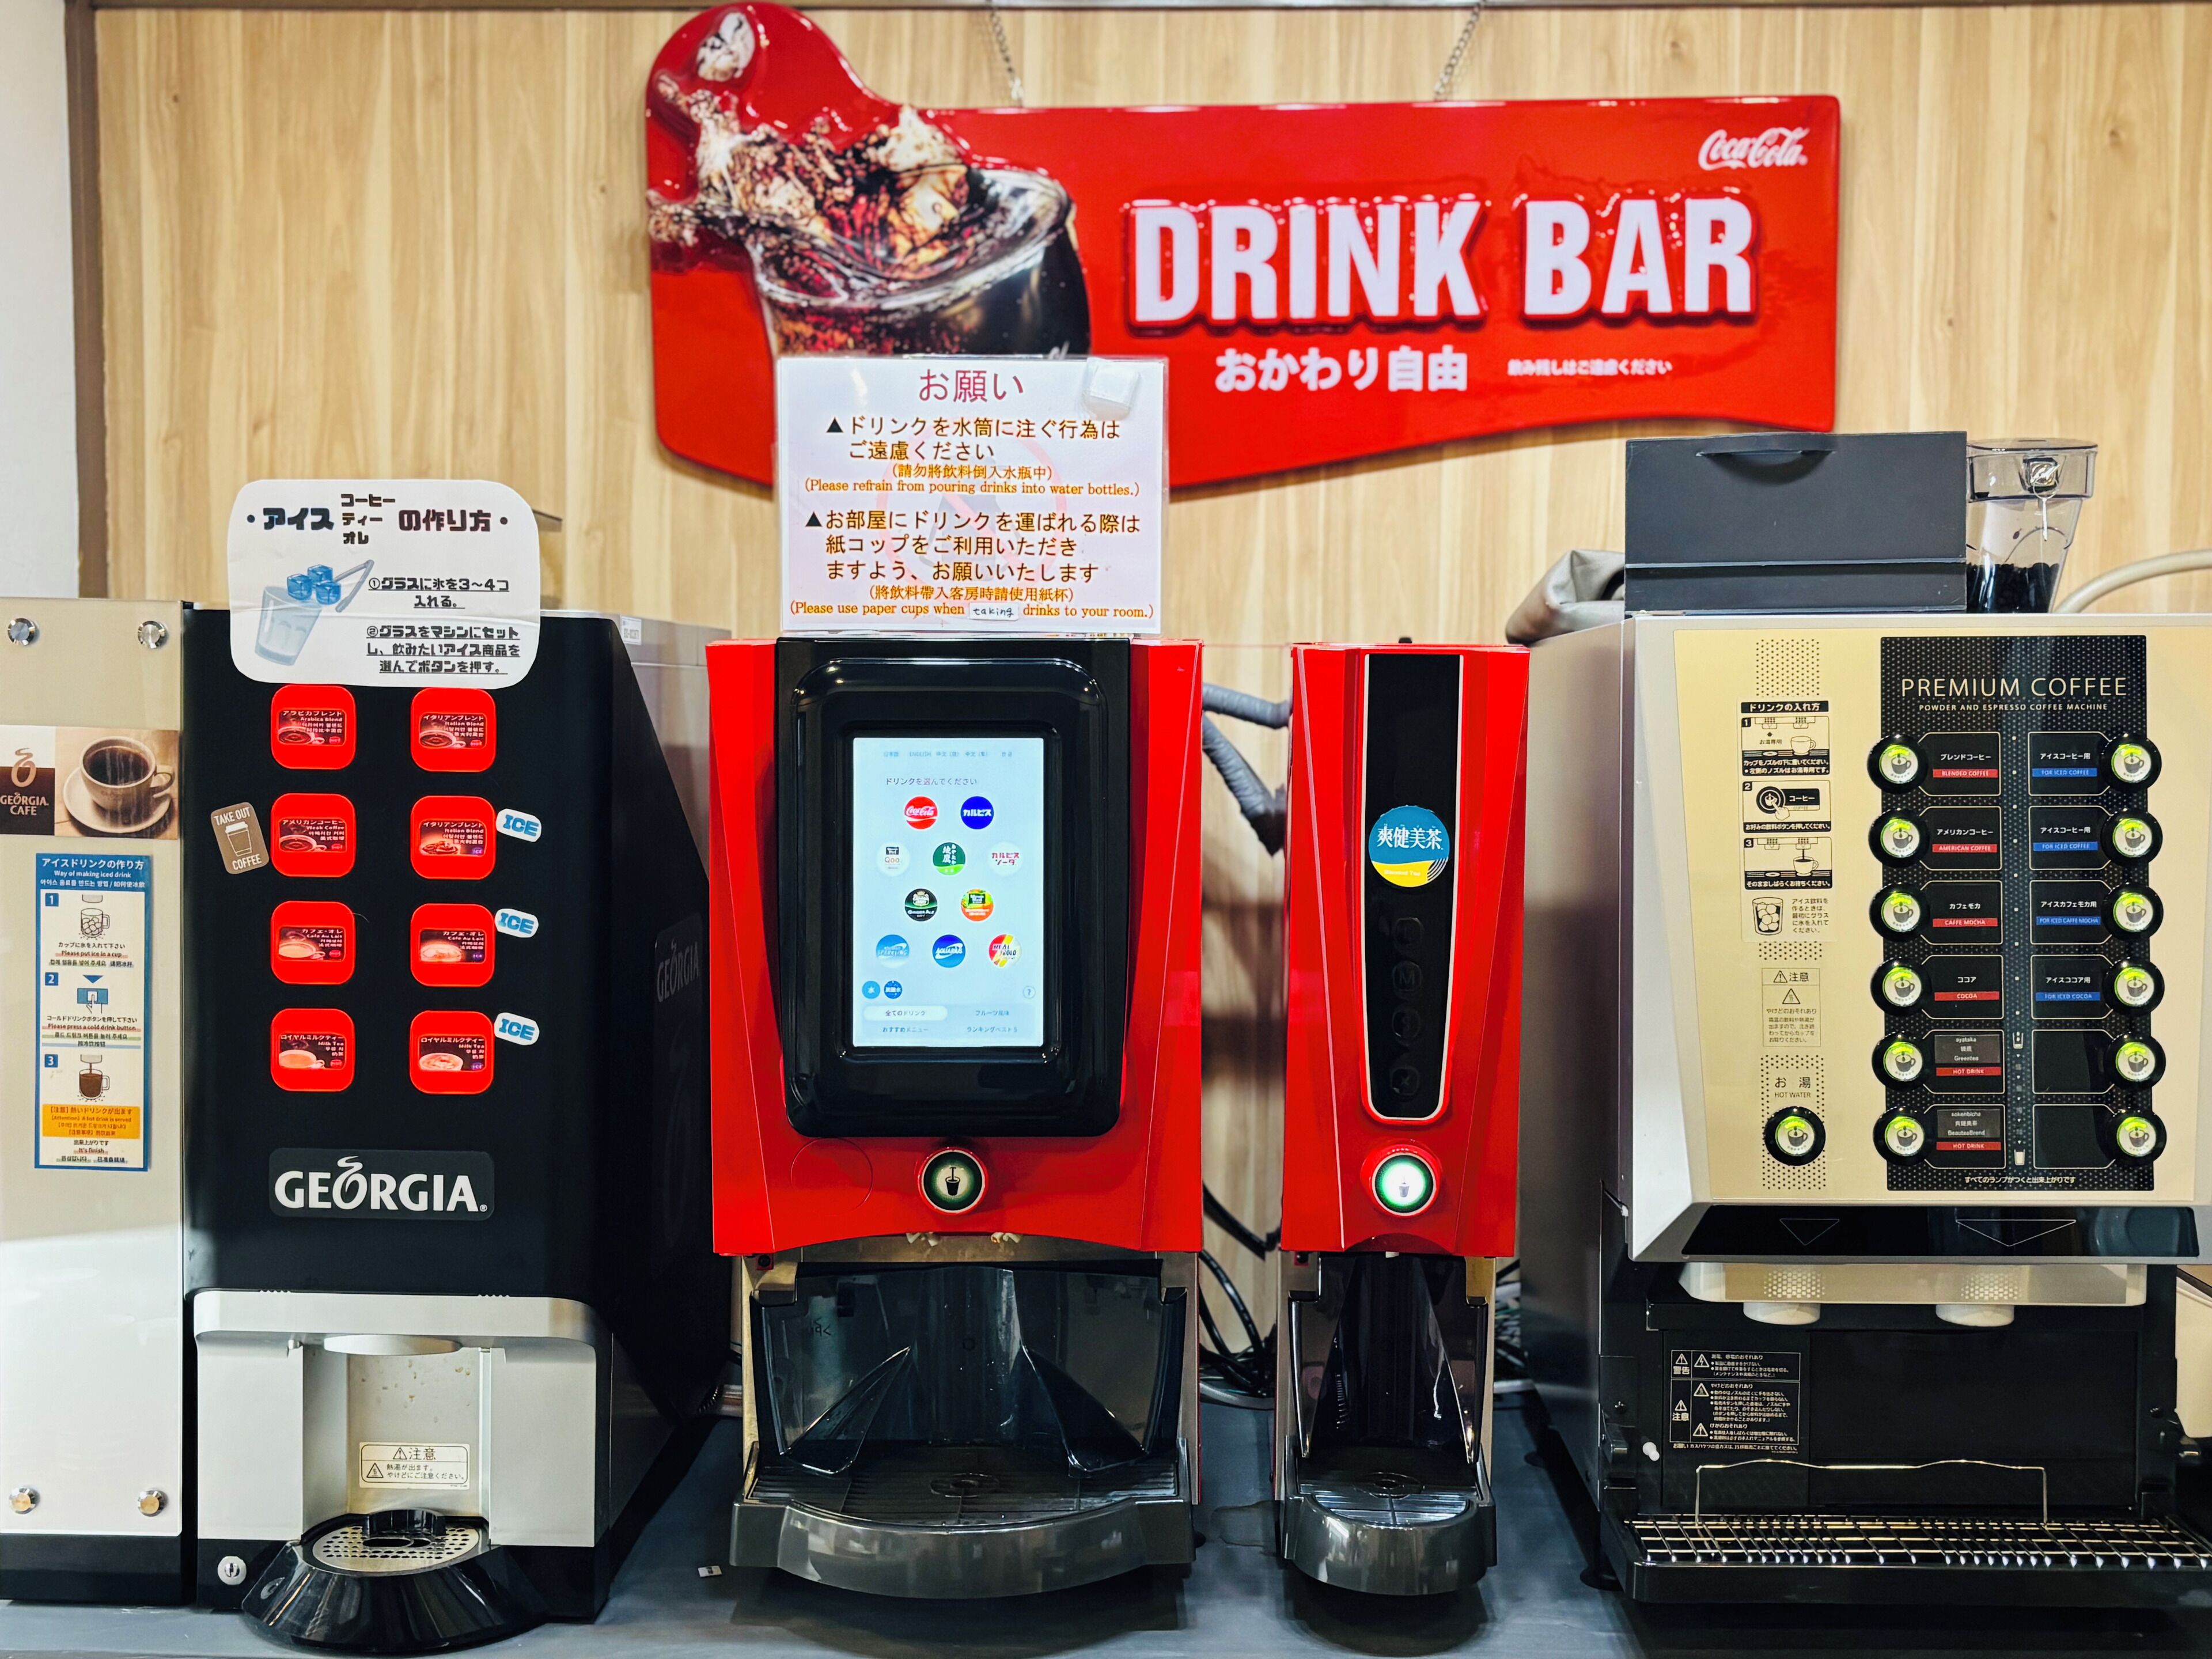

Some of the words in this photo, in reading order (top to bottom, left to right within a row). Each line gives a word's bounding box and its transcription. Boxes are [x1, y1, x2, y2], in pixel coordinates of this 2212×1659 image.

[1699, 127, 1810, 171] Coca-Cola
[1135, 200, 1484, 323] DRINK
[1524, 198, 1752, 316] BAR
[1215, 345, 1467, 392] おかわり自由
[919, 369, 1024, 403] お願い
[850, 417, 1120, 440] ドリンクを水筒に注ぐ行為は
[850, 441, 994, 461] ご遠慮ください
[805, 478, 849, 492] (Please
[853, 479, 893, 491] refrain
[897, 480, 924, 491] from
[929, 480, 975, 494] pouring
[980, 482, 1017, 493] drinks
[1022, 482, 1046, 494] into
[1050, 484, 1084, 495] water
[1088, 482, 1139, 497] bottles.)
[340, 494, 396, 507] コーヒー
[263, 507, 334, 531] アイス
[399, 509, 491, 531] の作り方
[342, 513, 382, 525] ティー
[343, 532, 369, 544] オレ
[825, 536, 1077, 555] 紙コップをご利用いただき
[827, 562, 1099, 582] ますよう、お願いいたします
[414, 595, 460, 608] 入れる。
[790, 600, 834, 615] (Please
[838, 604, 858, 613] use
[863, 604, 897, 616] paper
[902, 604, 929, 616] cups
[934, 603, 964, 614] when
[973, 608, 1014, 618] taking
[1023, 604, 1060, 616] drinks
[1065, 607, 1077, 616] to
[1082, 608, 1109, 619] your
[1113, 605, 1154, 619] room.)
[366, 626, 519, 638] ②グラスをマシンにセット
[366, 643, 520, 657] し、飲みたいアイス商品を
[380, 660, 502, 673] 選んでボタンを押す。
[1902, 677, 2020, 697] PREMIUM
[2031, 677, 2128, 696] COFFEE
[1749, 703, 1820, 712] ドリンクの入れ方
[2040, 752, 2091, 760] アイスコーヒー用
[10, 806, 37, 815] CAFE
[214, 812, 235, 825] TAKE
[235, 807, 251, 820] OUT
[963, 809, 992, 817] カルピス
[503, 815, 539, 836] ICE
[2040, 826, 2091, 834] アイスコーヒー用
[1377, 825, 1442, 850] 爽健美茶
[42, 858, 144, 870] アイスドリンクの作り方
[232, 854, 262, 870] COFFEE
[49, 895, 54, 904] 1
[498, 912, 535, 934] ICE
[657, 939, 699, 1002] GEORGIA
[1789, 972, 1809, 982] 注意
[48, 975, 54, 983] 2
[499, 1018, 535, 1041] ICE
[48, 1056, 54, 1065] 3
[1964, 1176, 2076, 1184] すべてのランプがつくと出来上がりです
[1673, 1366, 1690, 1374] 警告
[1672, 1412, 1690, 1421] 注意
[409, 1446, 436, 1460] 注意
